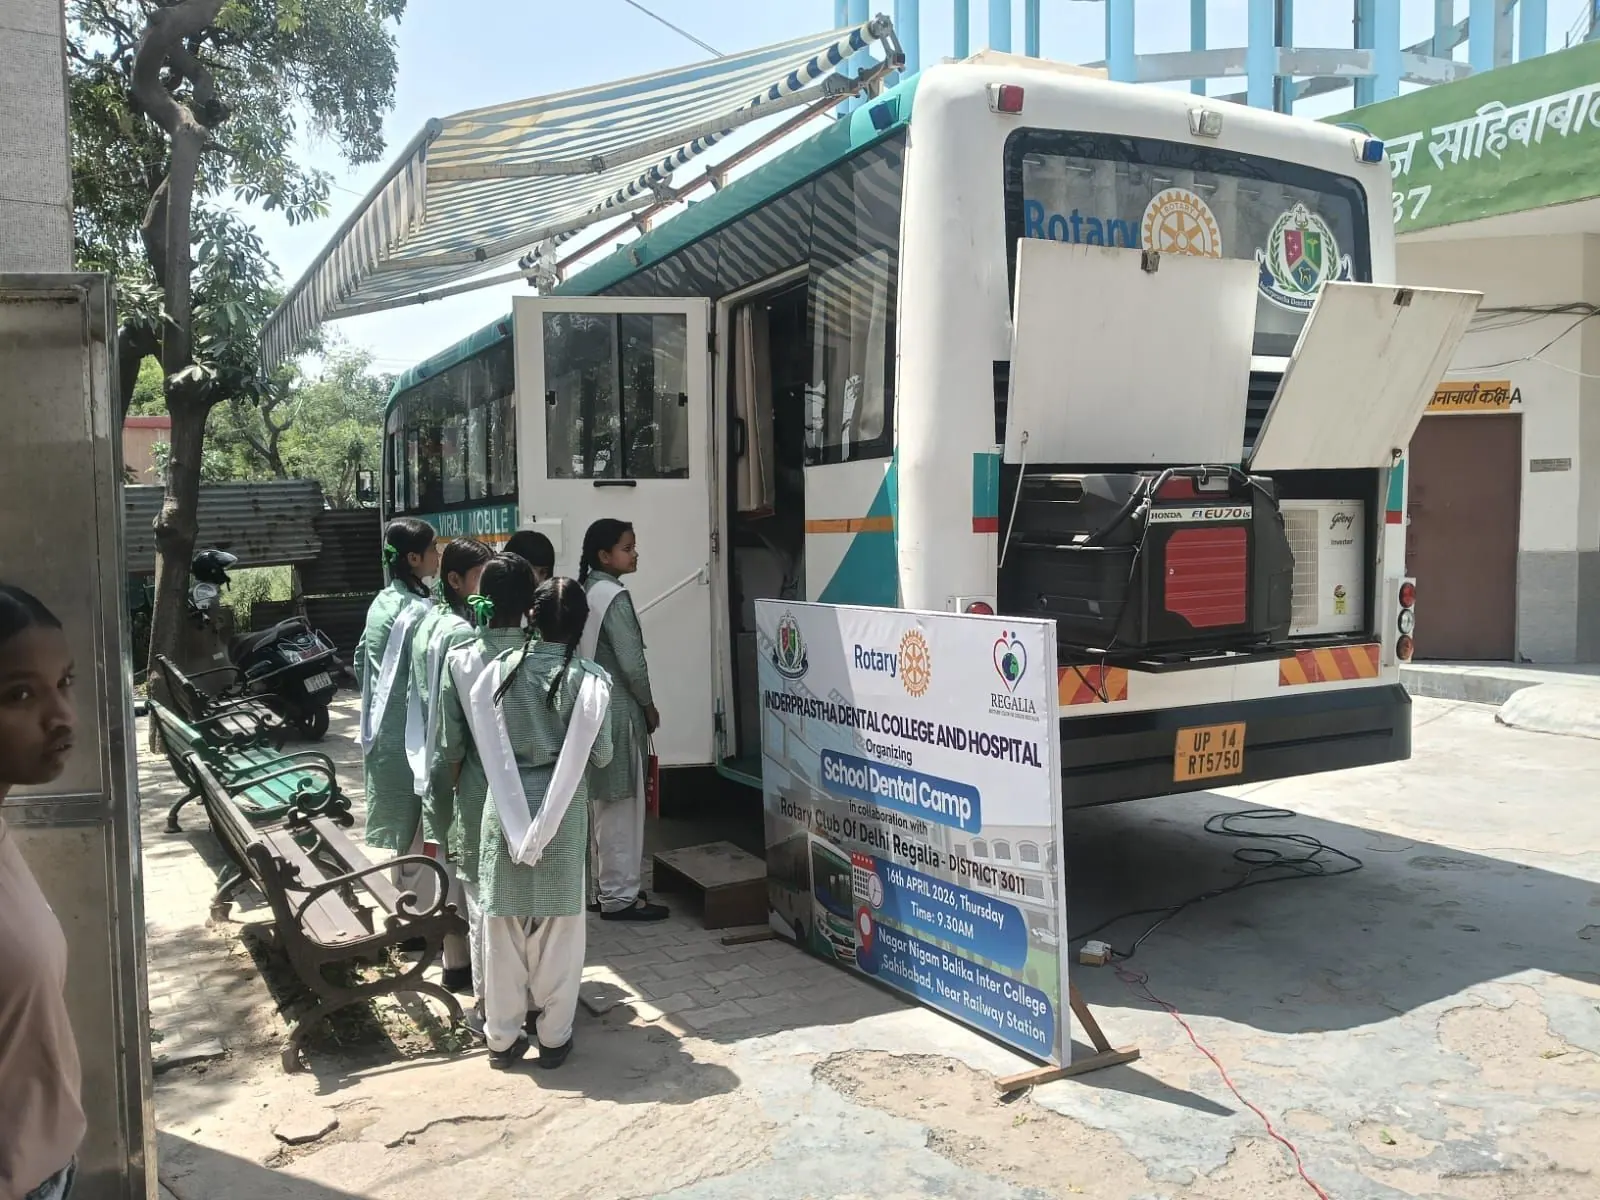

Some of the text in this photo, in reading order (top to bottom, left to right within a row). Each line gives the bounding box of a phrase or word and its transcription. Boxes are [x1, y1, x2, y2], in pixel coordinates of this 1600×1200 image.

[1164, 202, 1196, 214] ROTARY
[438, 513, 464, 537] VIRAJ
[469, 507, 509, 537] MOBILE
[1151, 511, 1183, 520] HONDA
[854, 644, 898, 678] Rotary
[991, 692, 1036, 714] REGALIA
[765, 689, 1042, 768] INDERPRASTHA DENTAL COLLEGE AND HOSPITAL
[1193, 728, 1237, 752] UP 14
[865, 738, 913, 766] Organizing
[1188, 749, 1240, 775] RT5750
[824, 759, 972, 829] School Dental Camp
[849, 799, 928, 836] In collaboration with
[780, 797, 812, 829] Rotary
[815, 808, 840, 834] Club
[843, 817, 857, 839] Of
[860, 822, 889, 851] Delhi
[893, 833, 940, 867] Regalia
[949, 854, 998, 887] DISTRICT
[1000, 870, 1025, 896] 3011
[886, 867, 1004, 930] 16th APRIL 2026, Thursday
[911, 901, 974, 939] Time: 9.30AM
[878, 927, 1047, 1016] Nagar Nigam Balika Inter College
[936, 977, 961, 1003] Near
[963, 991, 1004, 1028] Railway
[1006, 1012, 1046, 1043] Station
